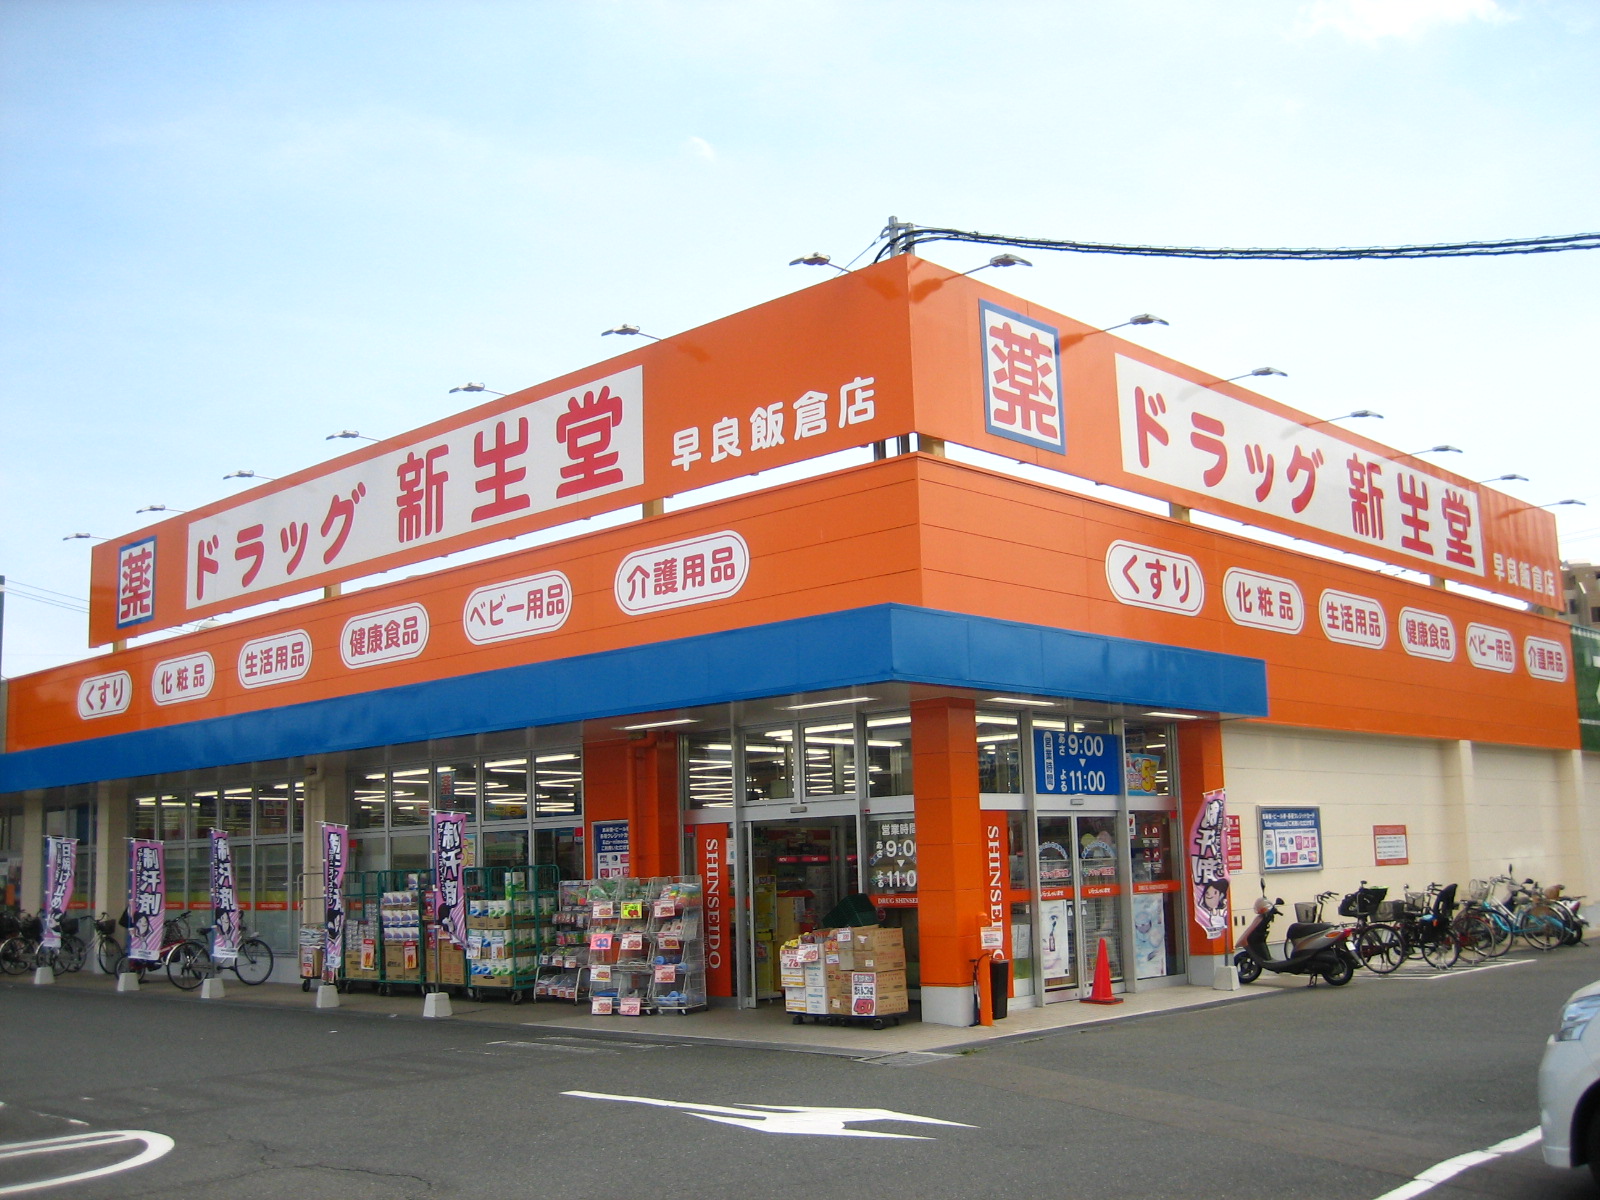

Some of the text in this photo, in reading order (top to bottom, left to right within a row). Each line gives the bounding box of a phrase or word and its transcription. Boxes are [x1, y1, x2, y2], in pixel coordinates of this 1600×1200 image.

[988, 319, 1060, 439] 薬
[671, 376, 875, 472] 早良飯倉店
[120, 547, 152, 620] 薬
[626, 546, 735, 601] 介護用品
[1122, 554, 1190, 604] くすり
[1493, 553, 1555, 597] 早良飯倉店
[470, 583, 564, 626] ベビー用品
[1236, 581, 1294, 621] 化粧品
[1326, 601, 1381, 638] 生活用品
[350, 615, 418, 657] 健康食品
[1406, 617, 1450, 651] 健康食品
[1469, 634, 1512, 663] ベビー用品
[245, 641, 304, 678] 生活用品
[1528, 645, 1563, 673] 介護用品
[85, 677, 124, 711] くすり
[161, 663, 205, 695] 化粧品
[1058, 733, 1104, 757] あさ 9:00
[1060, 769, 1068, 792] よる
[1069, 770, 1106, 792] 11:00
[876, 840, 916, 858] あさ 9:0
[140, 847, 162, 916] 制汗剤
[877, 870, 885, 888] よる
[705, 839, 721, 969] SHINSEIDO
